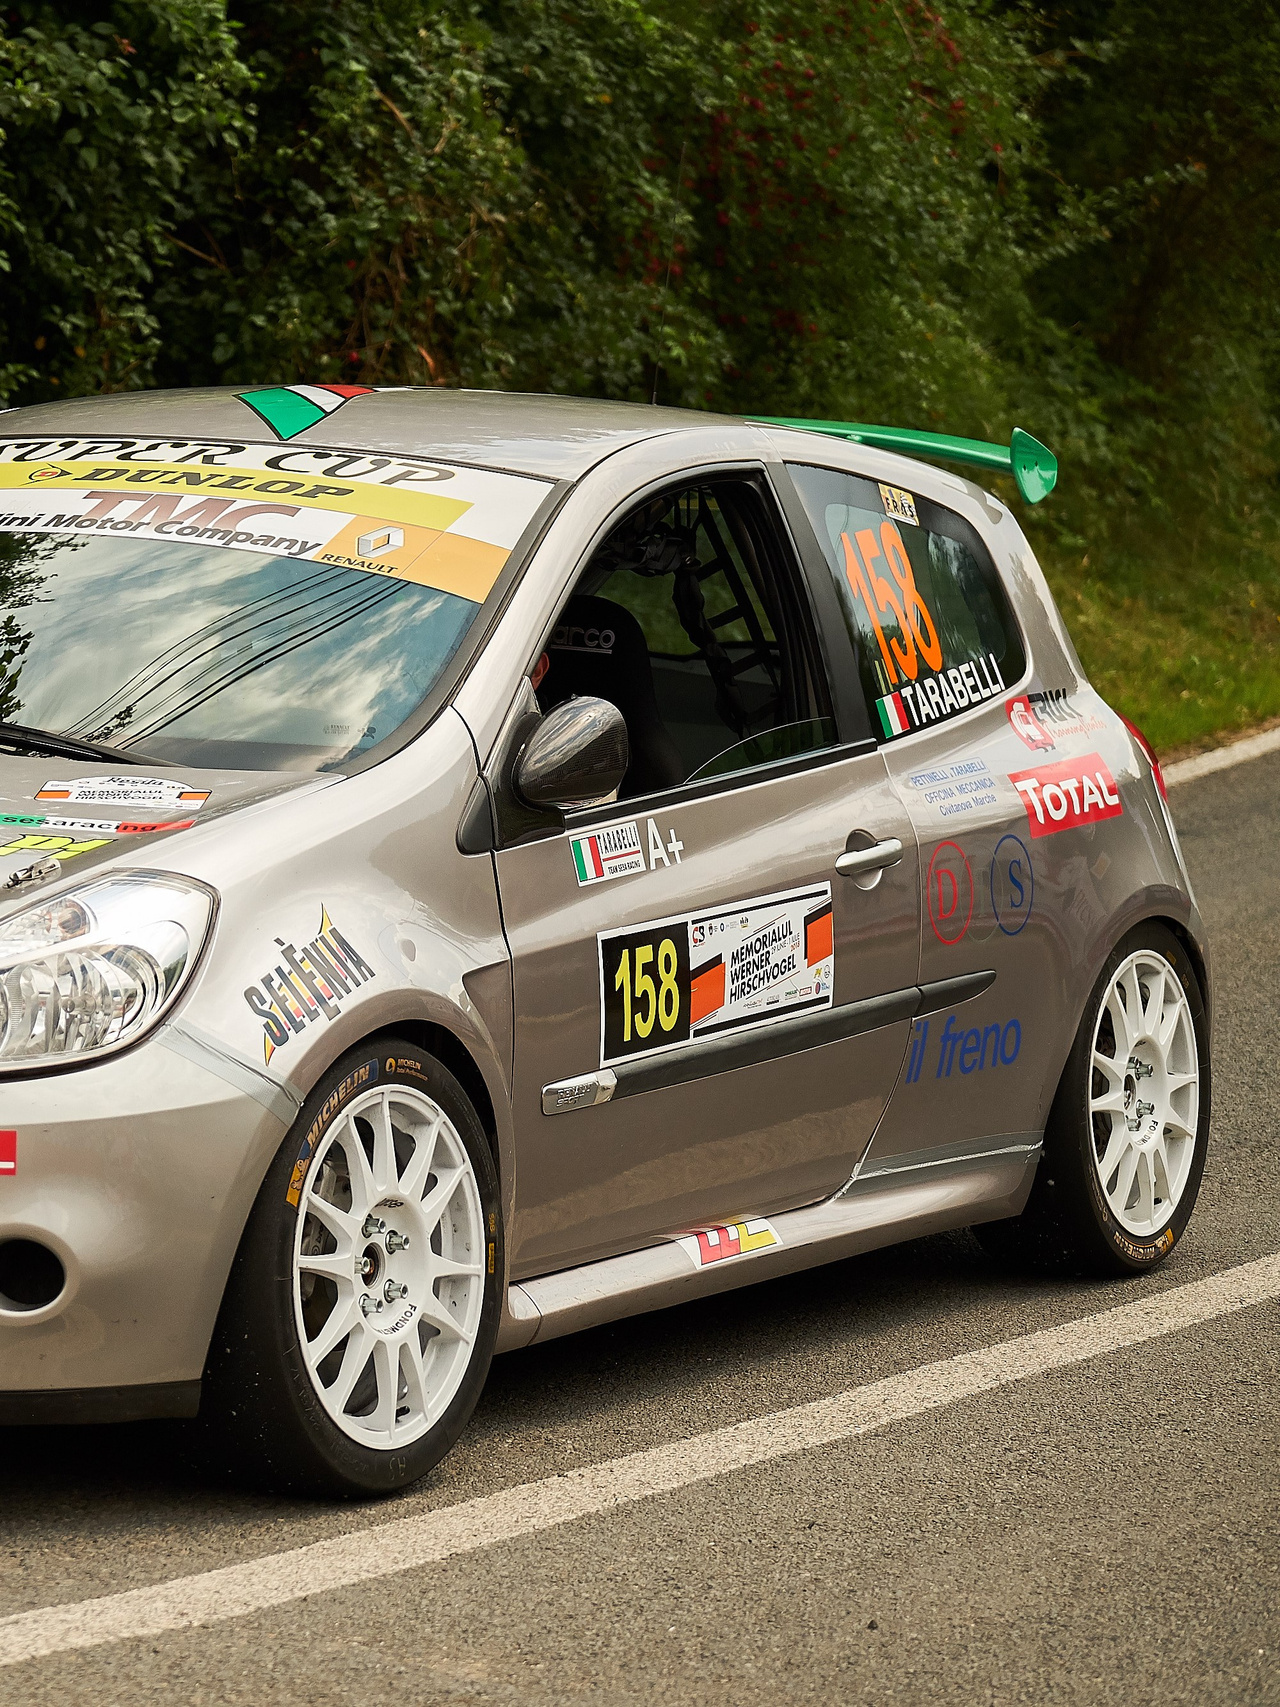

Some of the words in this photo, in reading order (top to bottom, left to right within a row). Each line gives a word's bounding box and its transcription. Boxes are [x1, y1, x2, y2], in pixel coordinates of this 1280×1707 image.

[71, 467, 355, 499] DUNLOP
[265, 450, 456, 486] CUP
[81, 490, 302, 530] TMC
[42, 513, 154, 532] Motor
[160, 519, 324, 557] Company
[320, 553, 399, 575] RENAULT
[840, 521, 943, 685] 158
[552, 625, 616, 649] arco
[901, 653, 1006, 726] TARABELLI
[910, 770, 950, 787] PETTINELLI
[949, 760, 987, 778] TARABELLI
[924, 787, 957, 804] OFFICINA
[955, 777, 996, 796] MECCANICA
[939, 800, 973, 816] Civitanova
[971, 793, 997, 807] Marche
[2, 815, 159, 833] sesaracing
[596, 825, 640, 855] TARABELLI
[730, 920, 793, 969] MEMORIALUL
[729, 953, 797, 1005] HIRSCHVOGEL
[730, 950, 771, 985] WERNER
[615, 938, 680, 1042] 158
[905, 1020, 930, 1084] il
[936, 1015, 1023, 1079] freno
[306, 1064, 370, 1146] MICHELIN
